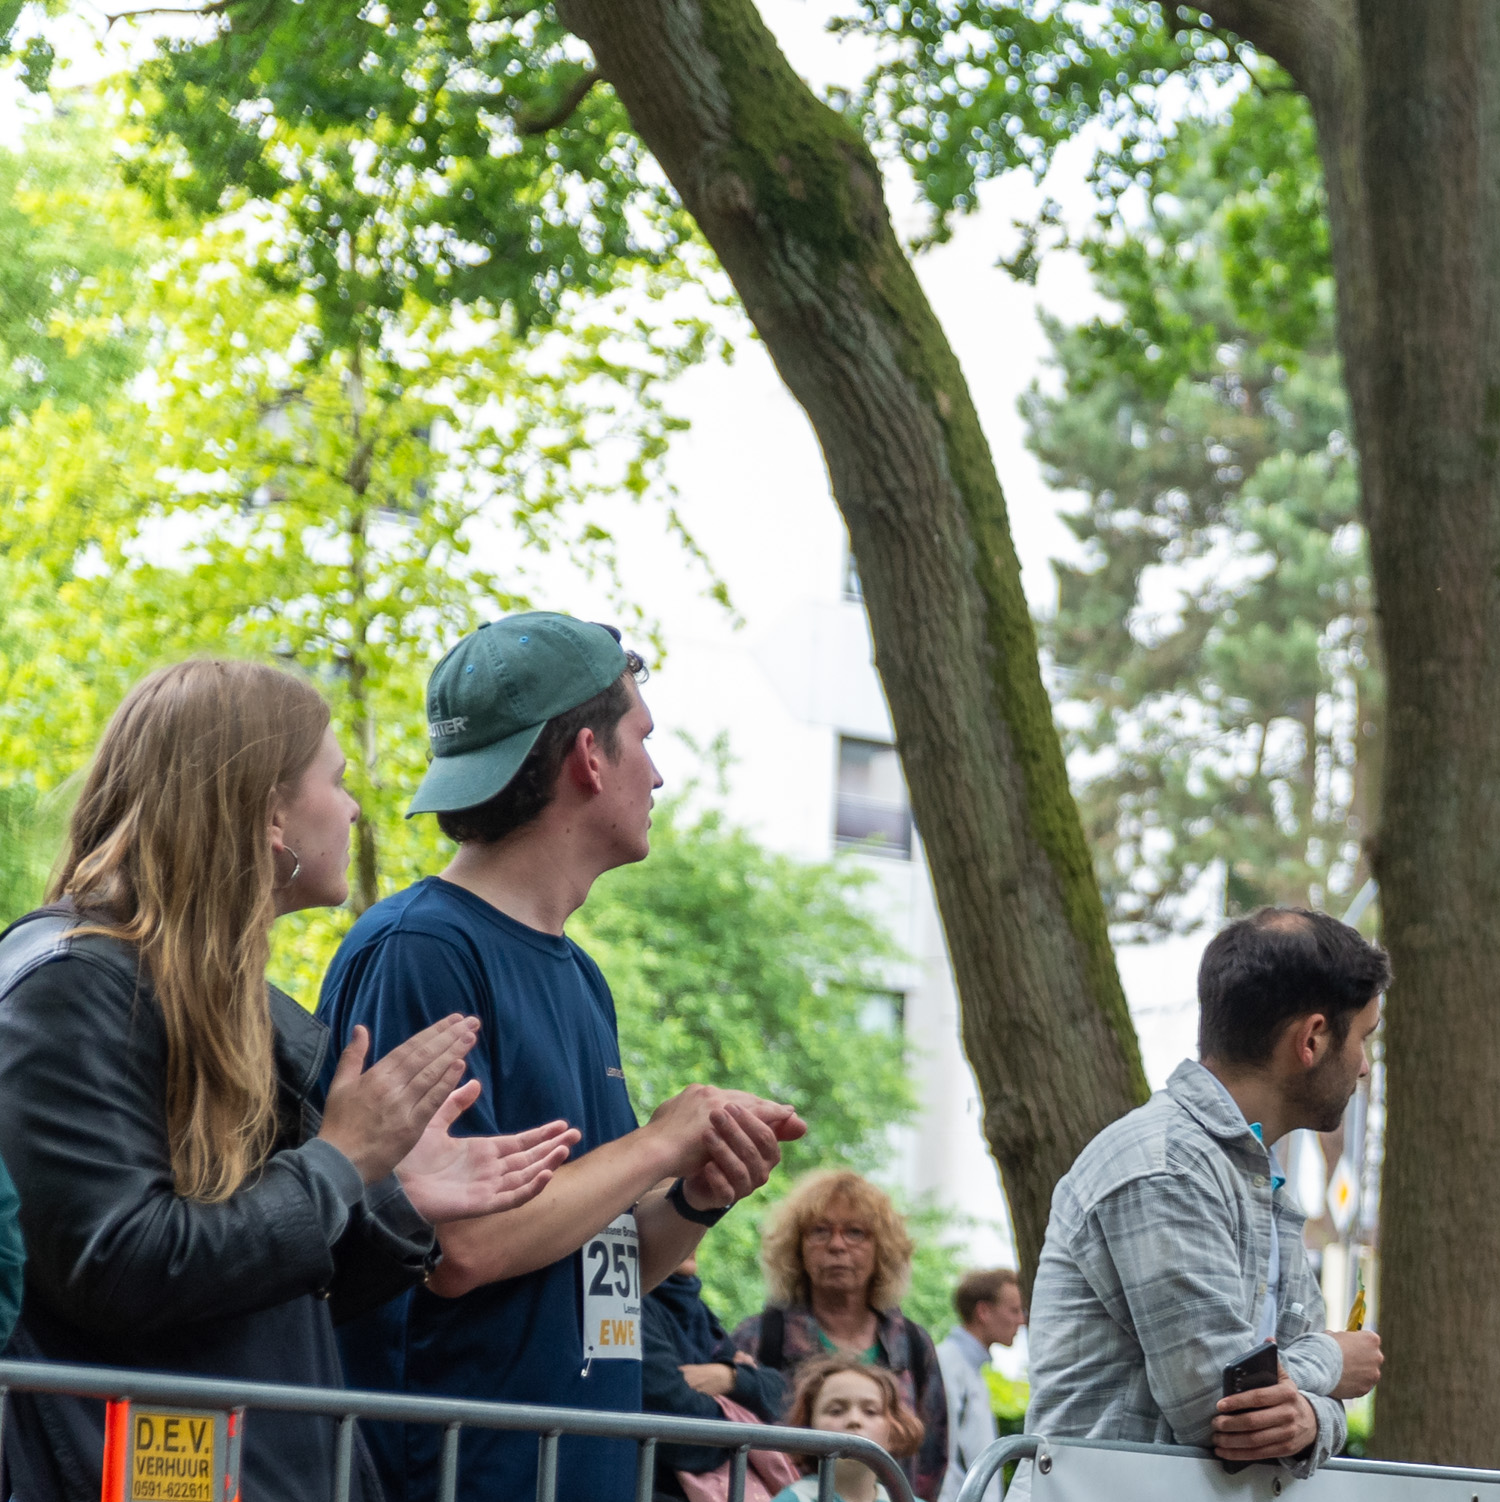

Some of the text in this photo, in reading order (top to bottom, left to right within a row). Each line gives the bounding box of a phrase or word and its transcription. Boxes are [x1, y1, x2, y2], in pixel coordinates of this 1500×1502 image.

[600, 1319, 635, 1346] EWE
[136, 1417, 210, 1454] D.E.V.
[136, 1457, 209, 1478] VERHUUR
[134, 1480, 210, 1499] 0591-622611
